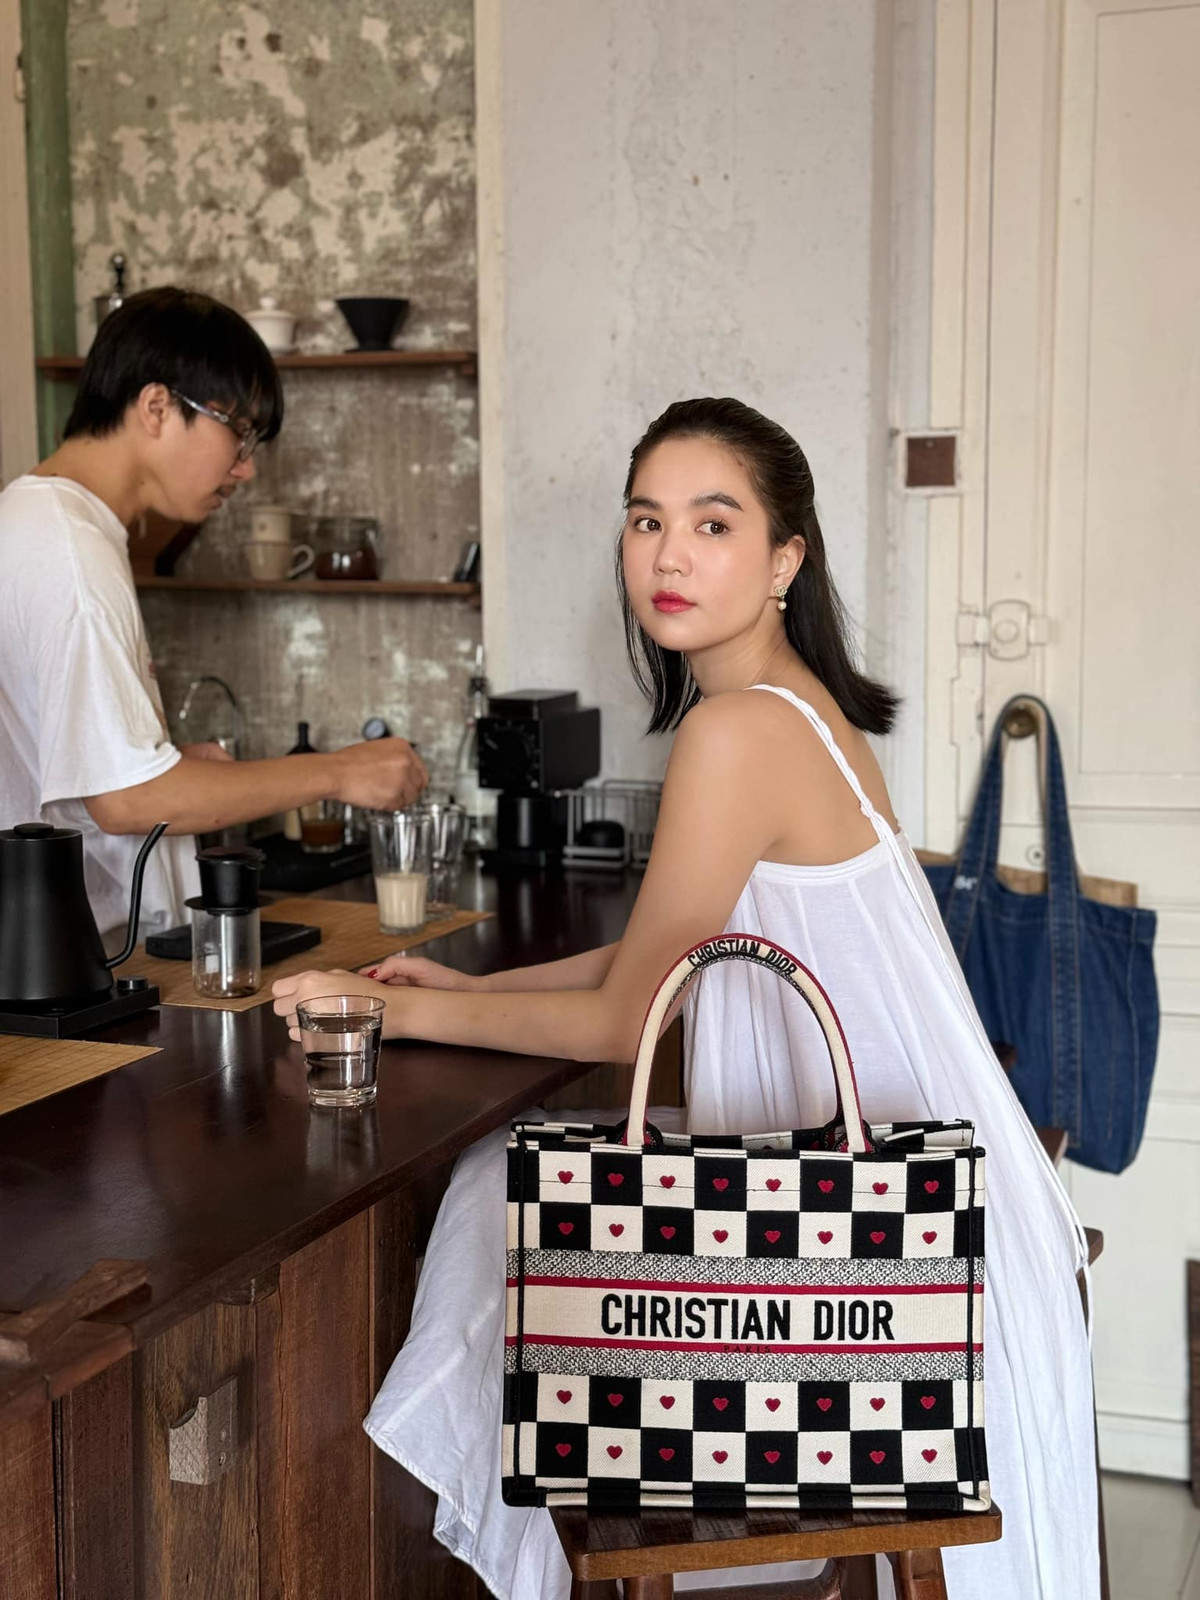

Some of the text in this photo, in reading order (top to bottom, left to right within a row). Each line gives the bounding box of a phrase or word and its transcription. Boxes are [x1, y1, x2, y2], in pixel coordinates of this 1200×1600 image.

[687, 938, 798, 976] CHRISTIAN DIOR
[601, 1293, 895, 1341] CHRISTIAN DIOR
[723, 1345, 772, 1354] PARIS
